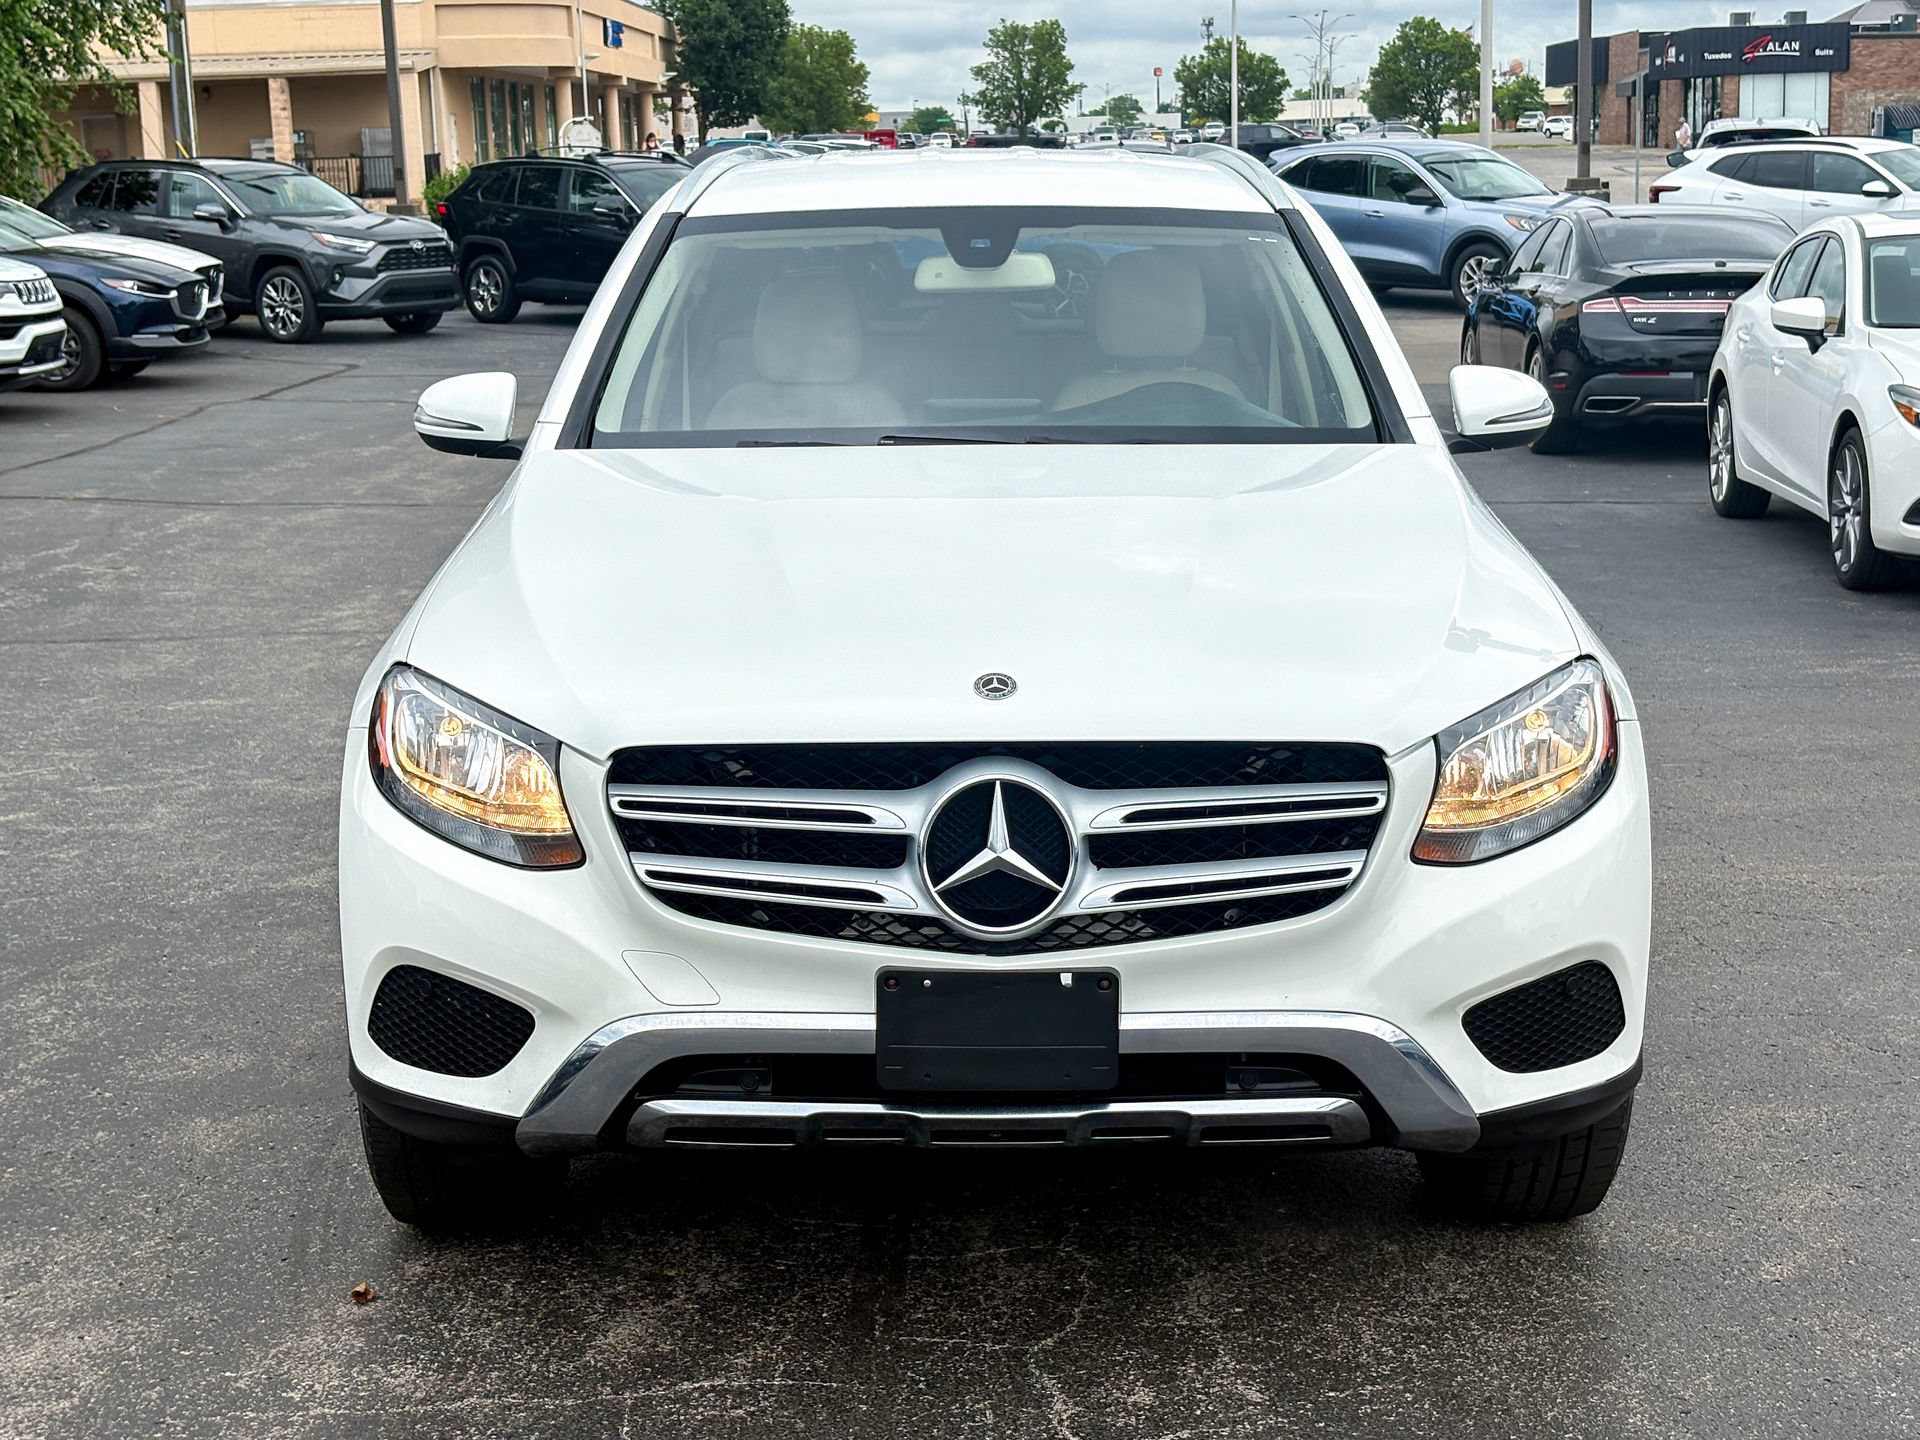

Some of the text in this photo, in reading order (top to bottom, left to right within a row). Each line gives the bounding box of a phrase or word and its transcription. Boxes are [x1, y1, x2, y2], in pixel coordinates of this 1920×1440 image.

[1703, 52, 1732, 60] Tuxedos
[1766, 41, 1800, 51] ALAN
[1815, 48, 1834, 56] Suits
